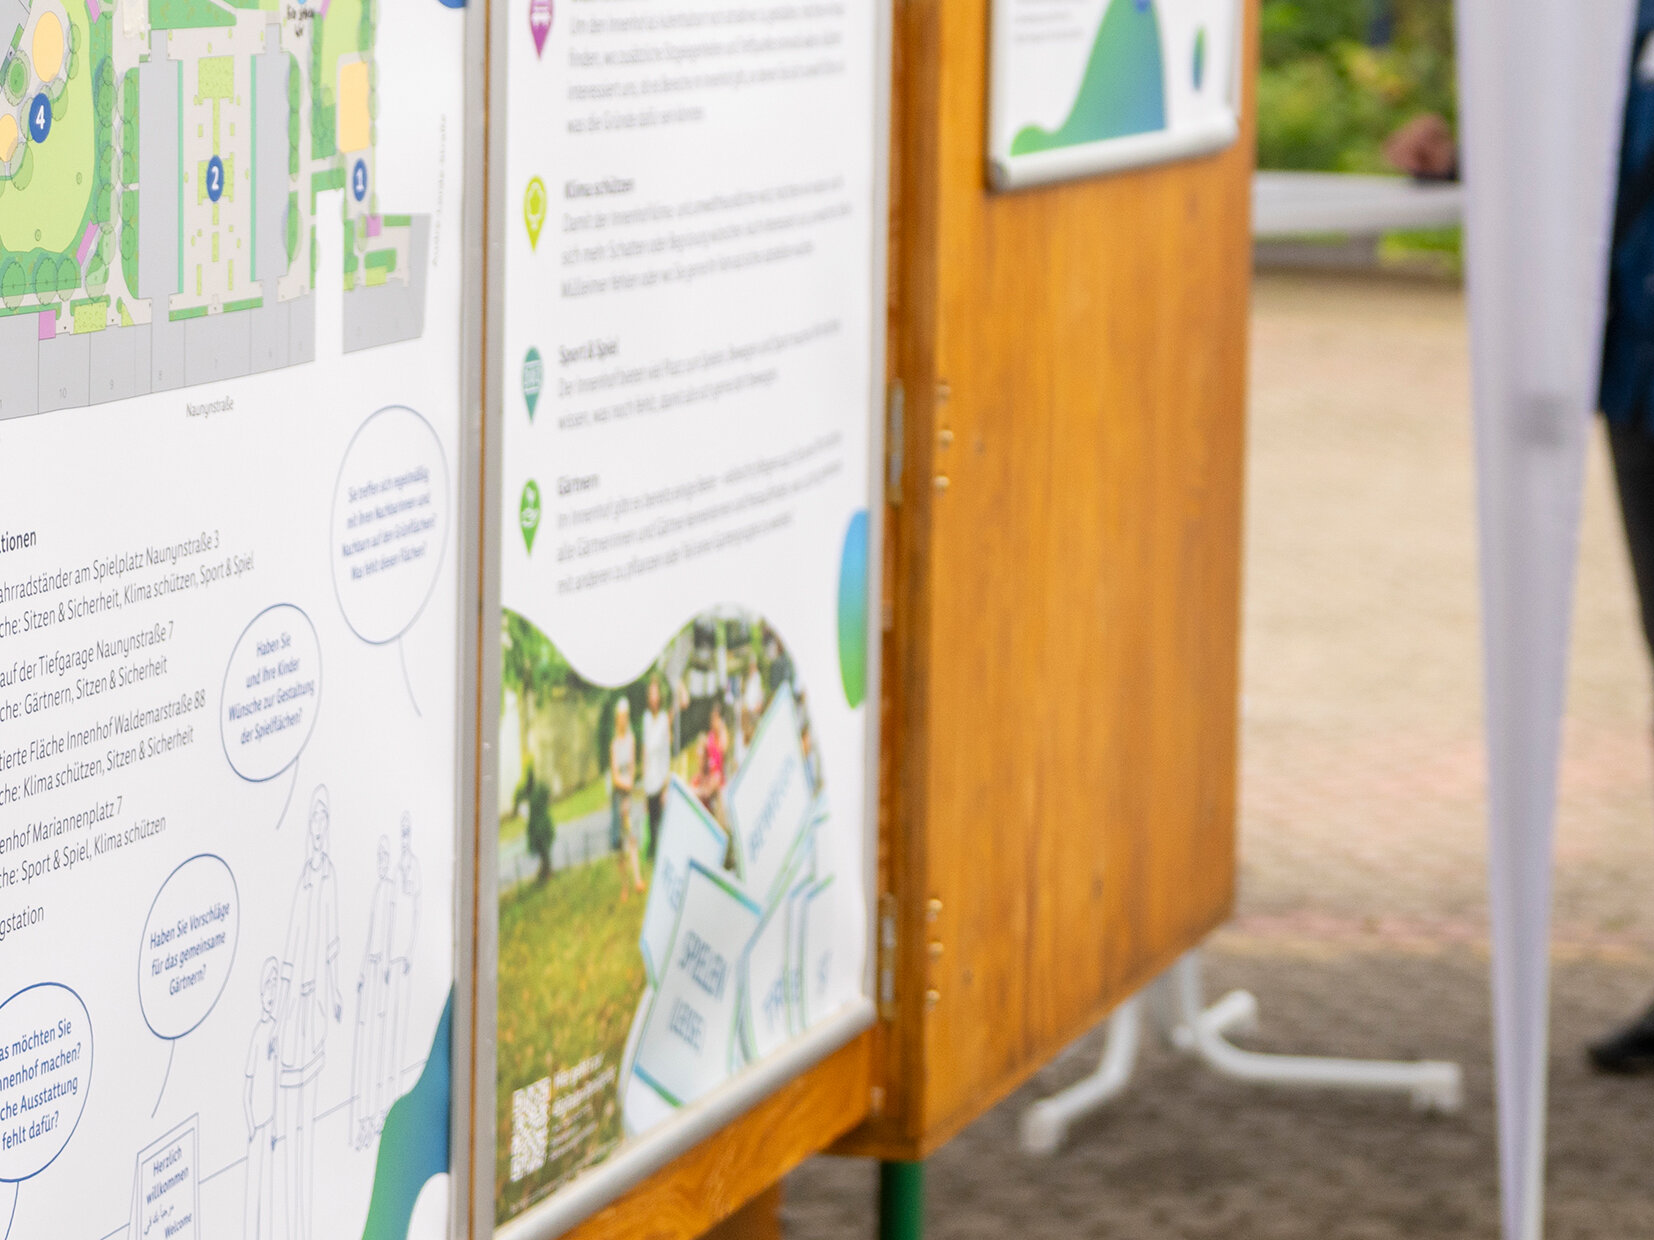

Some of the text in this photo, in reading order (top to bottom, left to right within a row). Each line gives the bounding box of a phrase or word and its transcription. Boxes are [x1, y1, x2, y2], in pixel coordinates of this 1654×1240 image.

[35, 104, 45, 130] 4
[210, 165, 220, 190] 2
[356, 167, 364, 192] 1
[185, 395, 235, 419] Naunynstraße
[0, 530, 38, 554] tionen
[0, 528, 221, 604] ahrradständer am Spielplatz Naunynstraße 3
[0, 550, 255, 639] che: Sitzen & Sicherheit, Klima schützen, Sport & Spiel
[0, 619, 175, 689] auf der Tiefgarage Naunynstraße 7
[0, 655, 169, 722] che: Gärtnern, Sitzen & Sicherheit
[29, 735, 65, 762] Fläche
[66, 715, 114, 751] Innenhof
[114, 692, 193, 736] Waldemarstraße
[193, 688, 207, 711] 88
[23, 773, 54, 799] Klima
[55, 757, 106, 789] schützen,
[106, 745, 138, 772] Sitzen
[139, 739, 146, 761] &
[147, 725, 195, 758] Sicherheit
[0, 794, 123, 855] enhof Mariannenplatz 7
[21, 855, 52, 885] Sport
[53, 849, 61, 871] &
[62, 839, 93, 870] Spiel,
[93, 832, 123, 857] Klima
[123, 816, 167, 847] schützen
[0, 905, 45, 942] gstation
[149, 902, 231, 951] Haben Sie Vorschläge
[151, 931, 226, 978] für das gemeinsame
[168, 963, 207, 997] Gärtnern?
[11, 1027, 56, 1057] möchten
[57, 1017, 73, 1040] Sie
[40, 1041, 82, 1076] machen?
[0, 1076, 79, 1122] che Ausstattung
[1, 1109, 60, 1152] fehlt dafür?
[145, 1166, 190, 1206] willkommen
